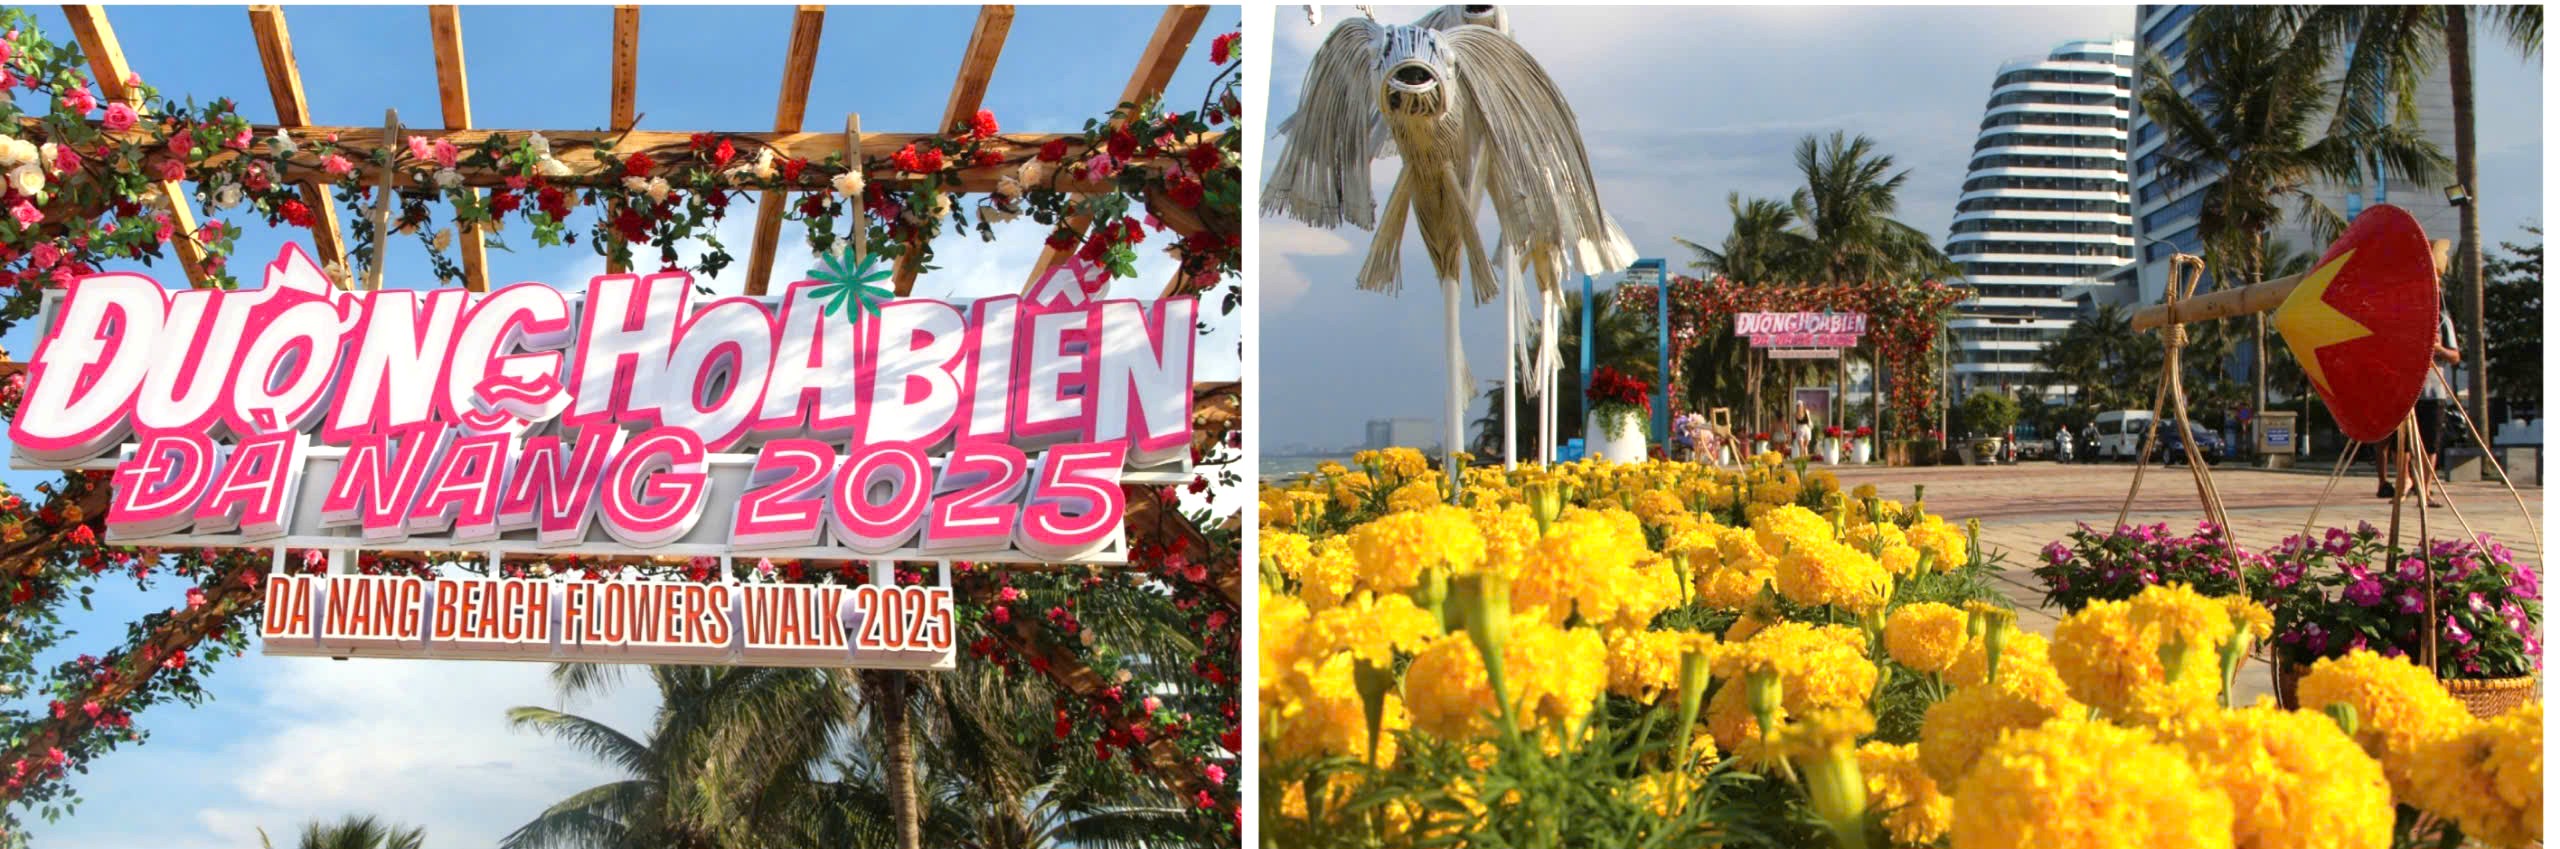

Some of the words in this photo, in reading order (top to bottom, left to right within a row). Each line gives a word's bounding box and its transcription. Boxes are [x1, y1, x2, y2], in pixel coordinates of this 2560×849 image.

[9, 241, 570, 450] ĐƯỜNG
[107, 407, 298, 530] ĐÀ
[321, 372, 708, 535] NẴNG
[735, 440, 1126, 547] 2025
[264, 575, 312, 636] DA
[324, 576, 422, 638] NANG
[434, 579, 549, 641] BEACH
[563, 582, 730, 646] FLOWERS
[743, 585, 844, 647] WALK
[857, 586, 953, 650] 2025
